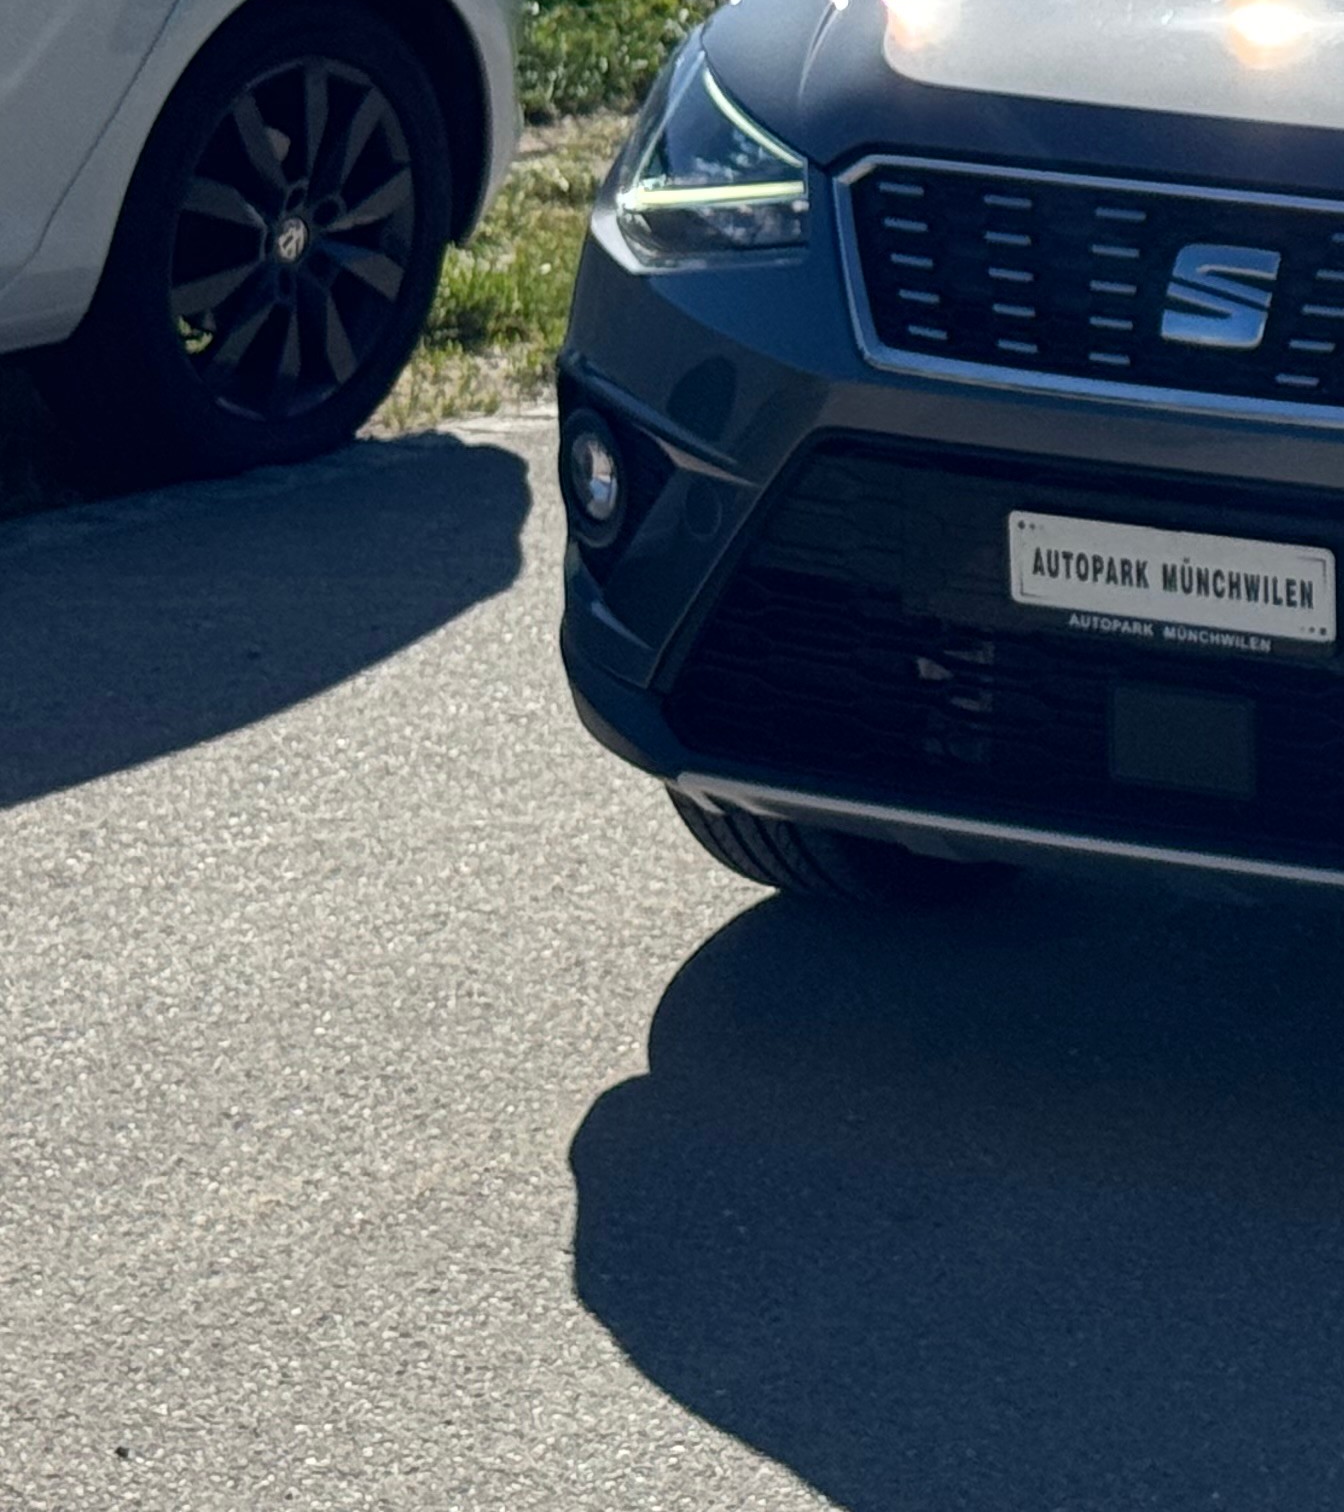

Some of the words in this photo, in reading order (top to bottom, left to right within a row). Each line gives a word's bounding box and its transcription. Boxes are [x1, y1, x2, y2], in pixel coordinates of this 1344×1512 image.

[1032, 546, 1150, 590] AUTOPARK
[1160, 556, 1316, 610] MÜNCHWILEN
[1067, 613, 1155, 638] AUTOPARK
[1162, 624, 1273, 654] MÜNCHWILEN
